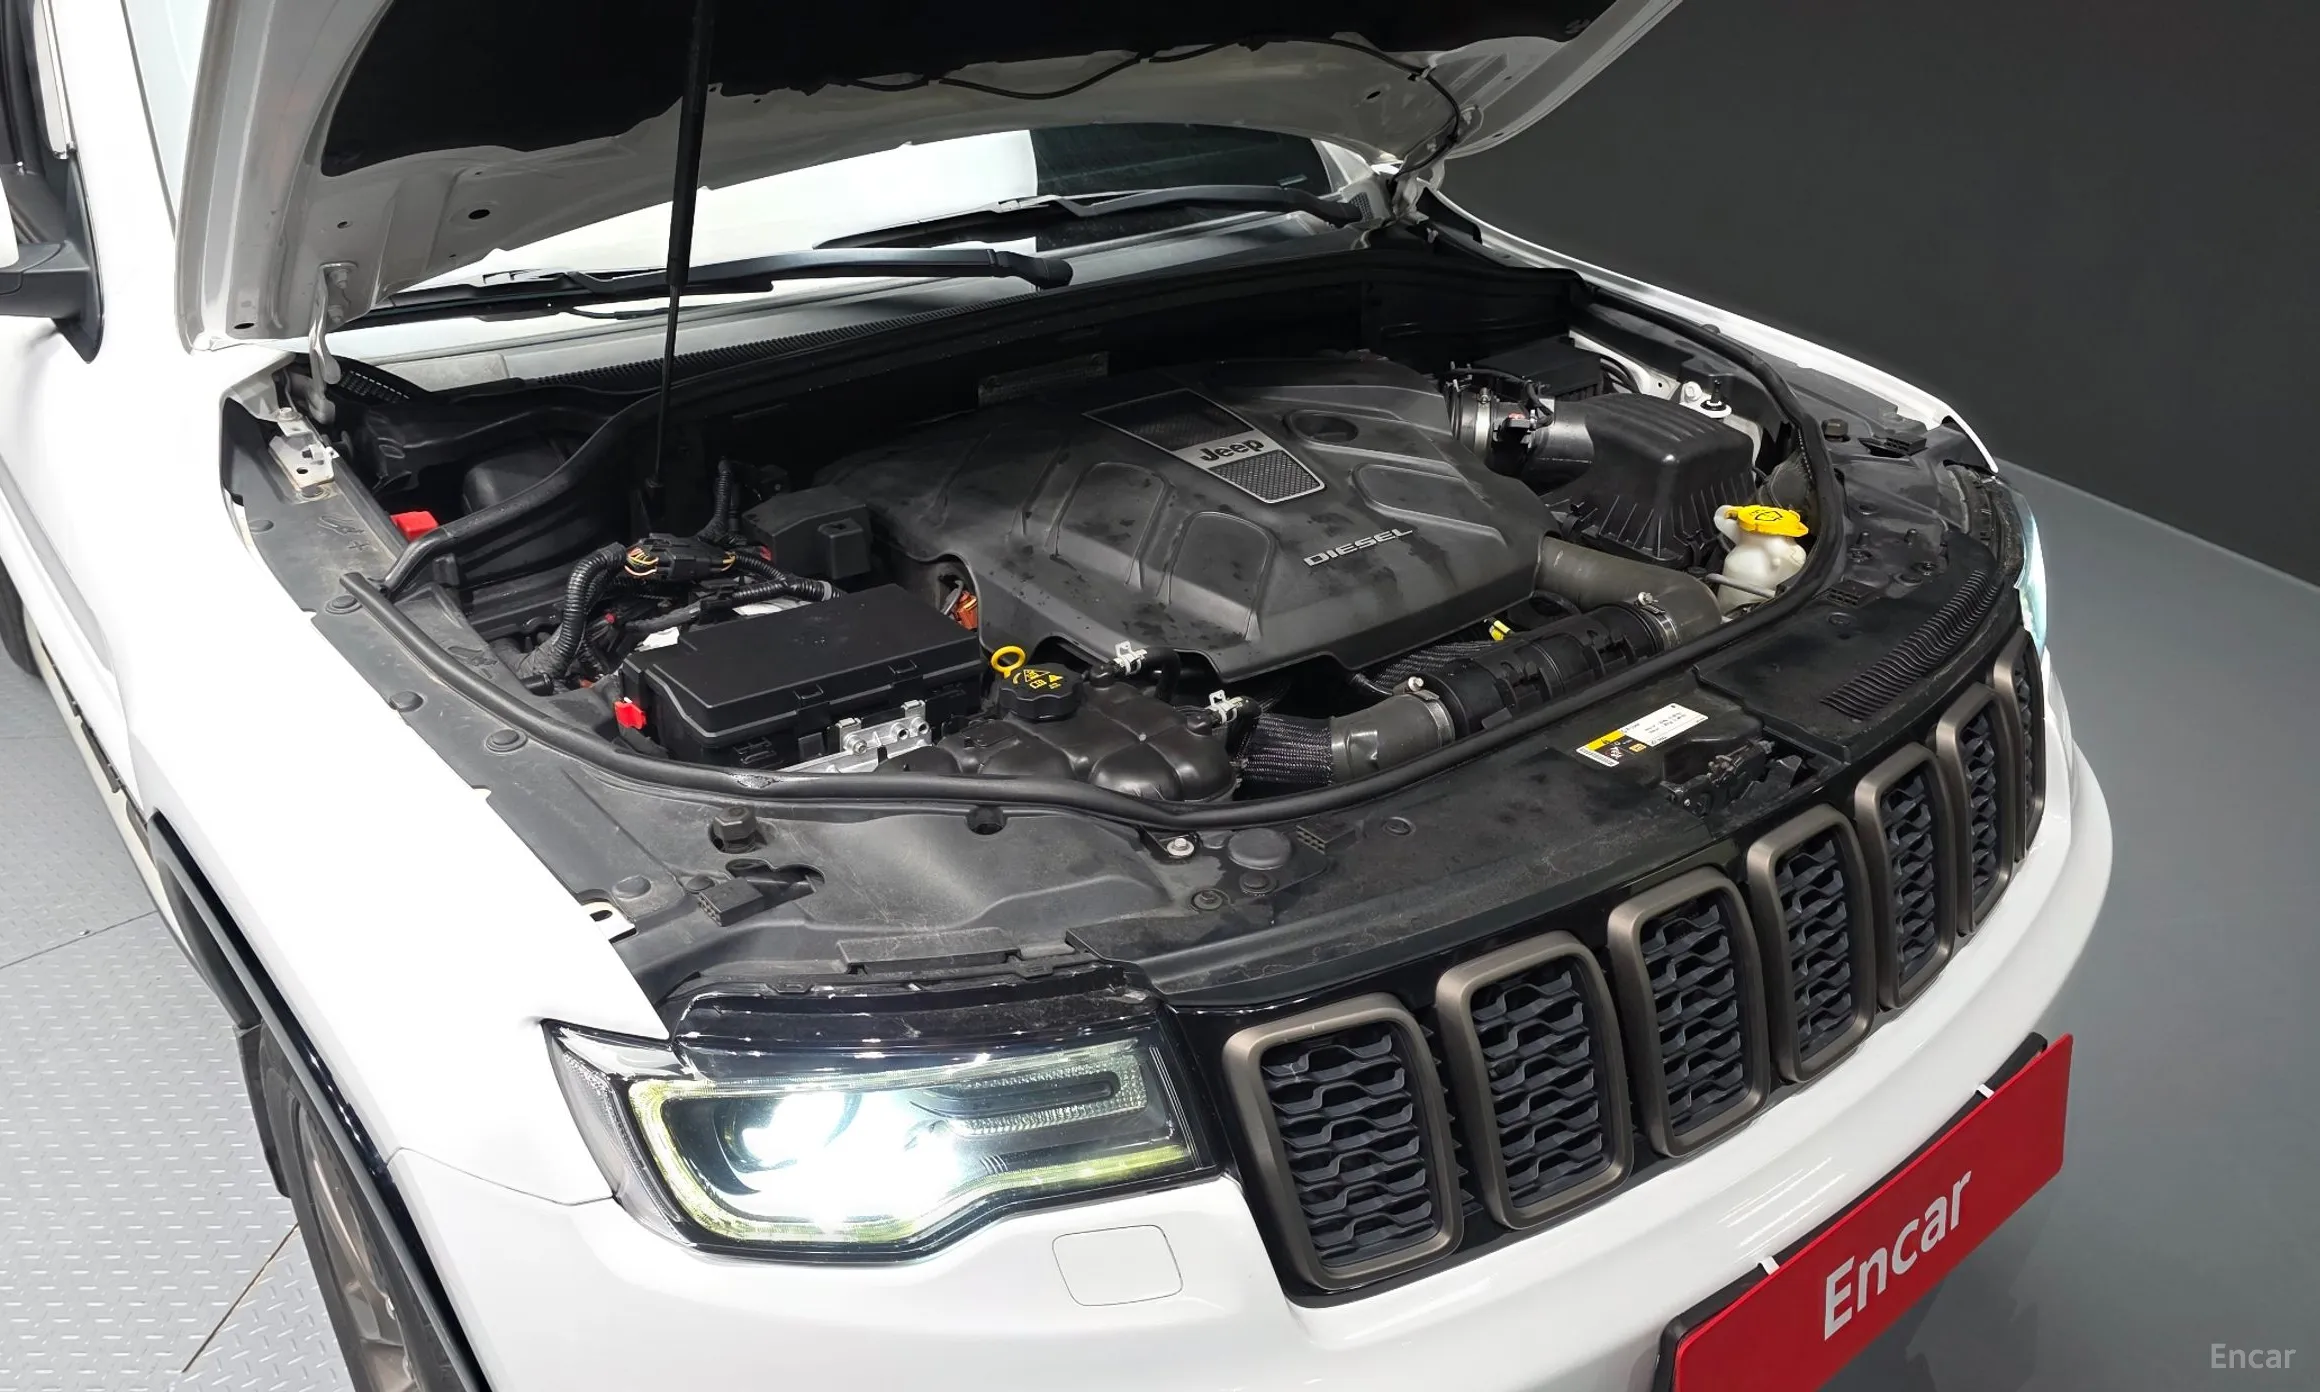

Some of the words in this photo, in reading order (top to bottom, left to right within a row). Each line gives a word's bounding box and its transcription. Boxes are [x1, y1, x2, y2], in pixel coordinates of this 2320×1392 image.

[1200, 439, 1264, 461] Jeep
[1303, 528, 1412, 566] DIESEL
[1824, 1171, 1971, 1341] Encar
